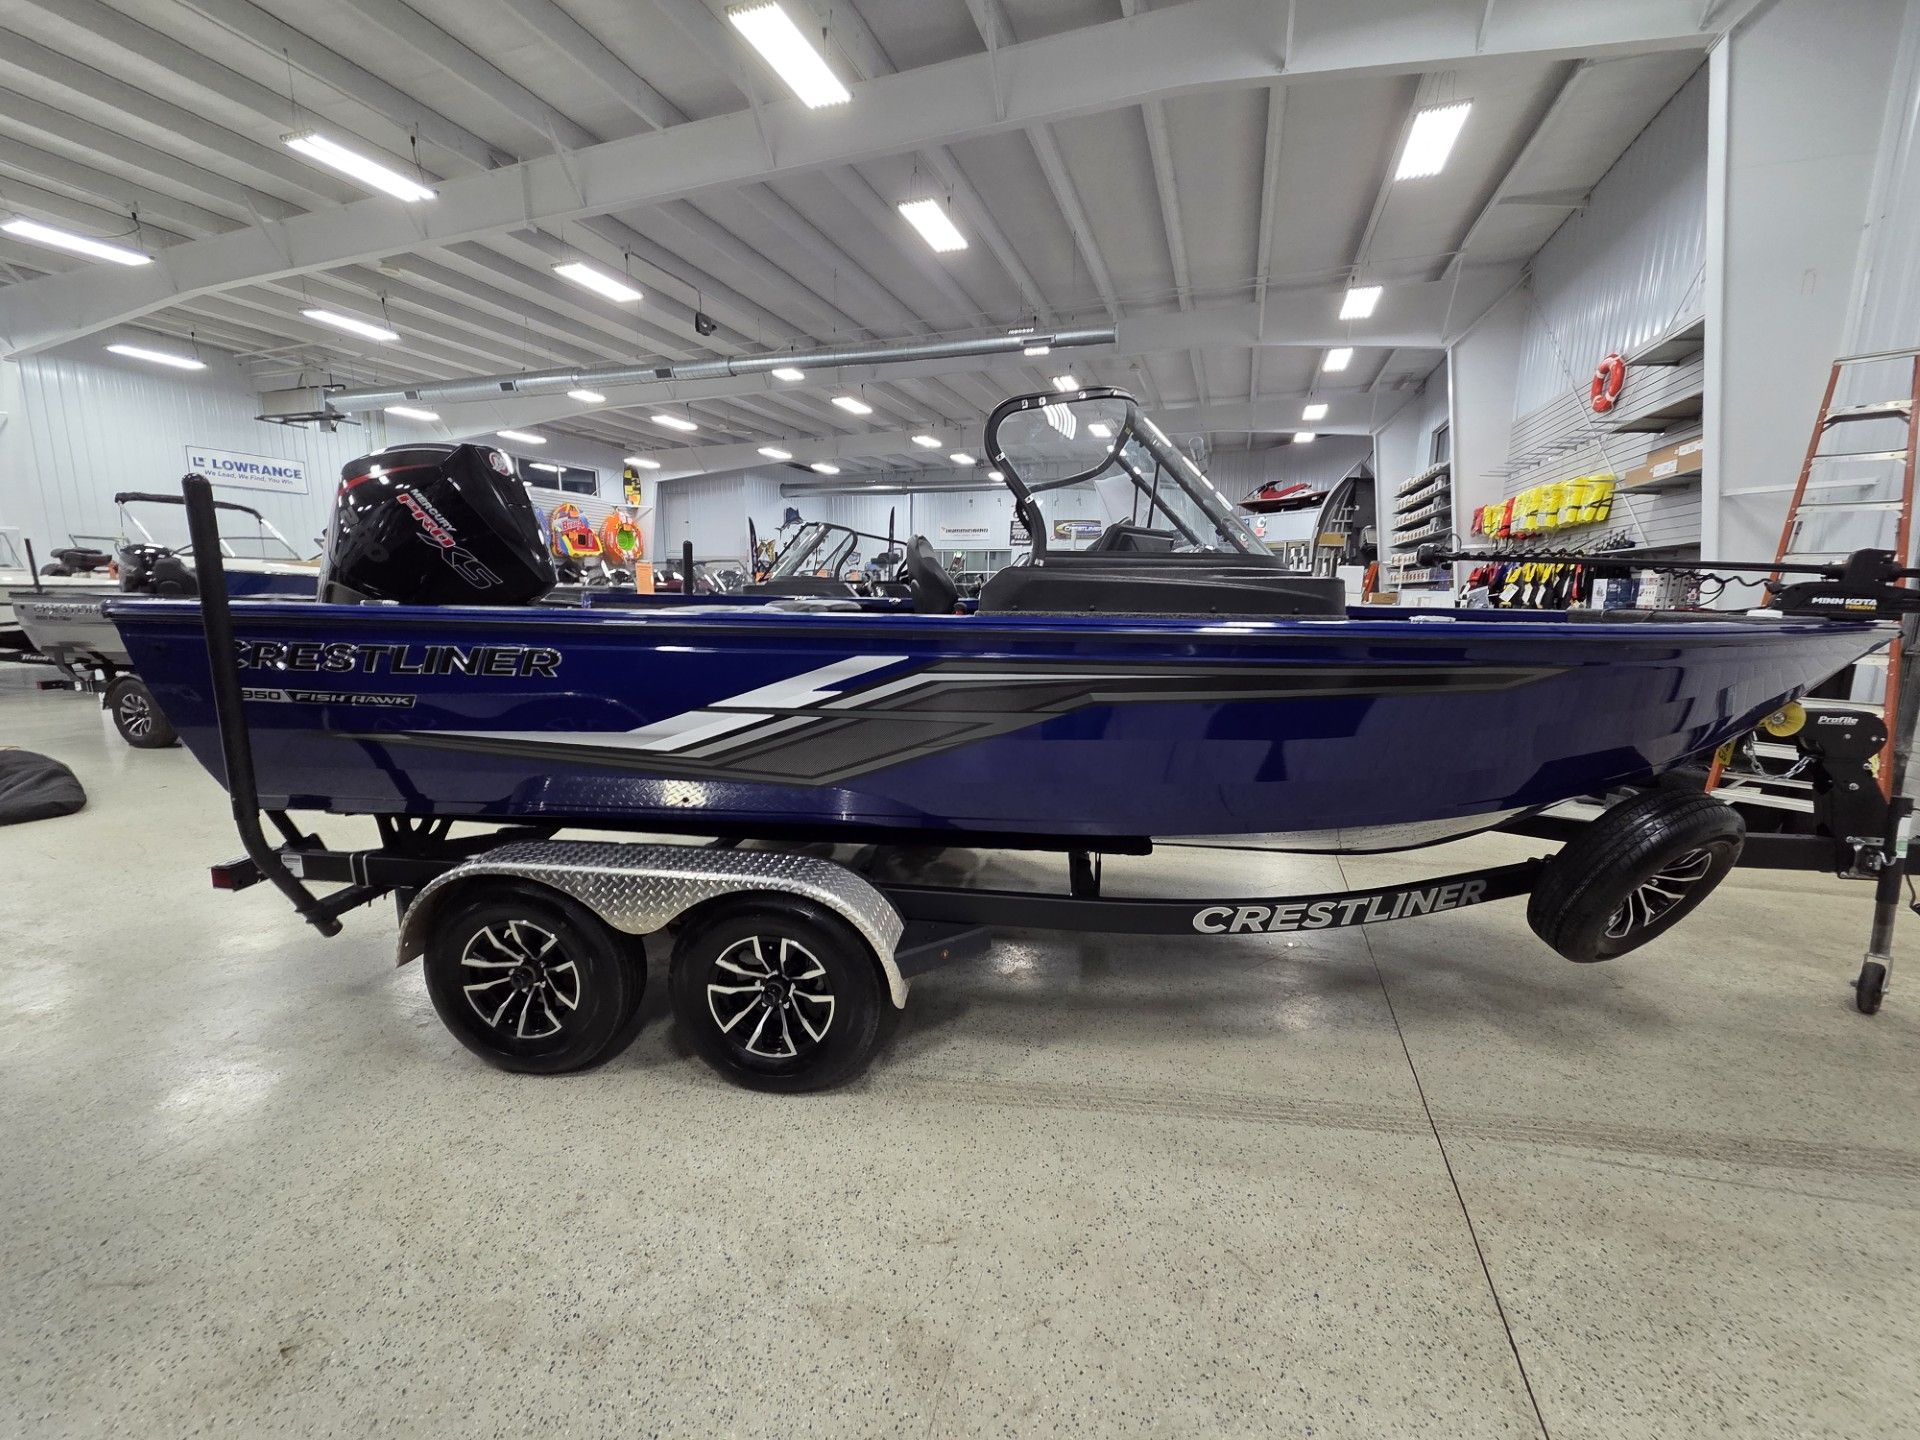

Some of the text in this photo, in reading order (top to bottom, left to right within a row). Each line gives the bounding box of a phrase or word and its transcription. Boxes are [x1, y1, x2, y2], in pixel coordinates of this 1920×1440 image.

[212, 459, 302, 479] LOWRANCE
[396, 492, 456, 548] PRO
[410, 488, 457, 532] MERCURY
[1812, 597, 1877, 606] MINN KOTA
[296, 693, 346, 703] FISH
[351, 695, 410, 706] HAWK
[1817, 716, 1859, 726] Profile
[1192, 880, 1488, 935] CRESTLINER
